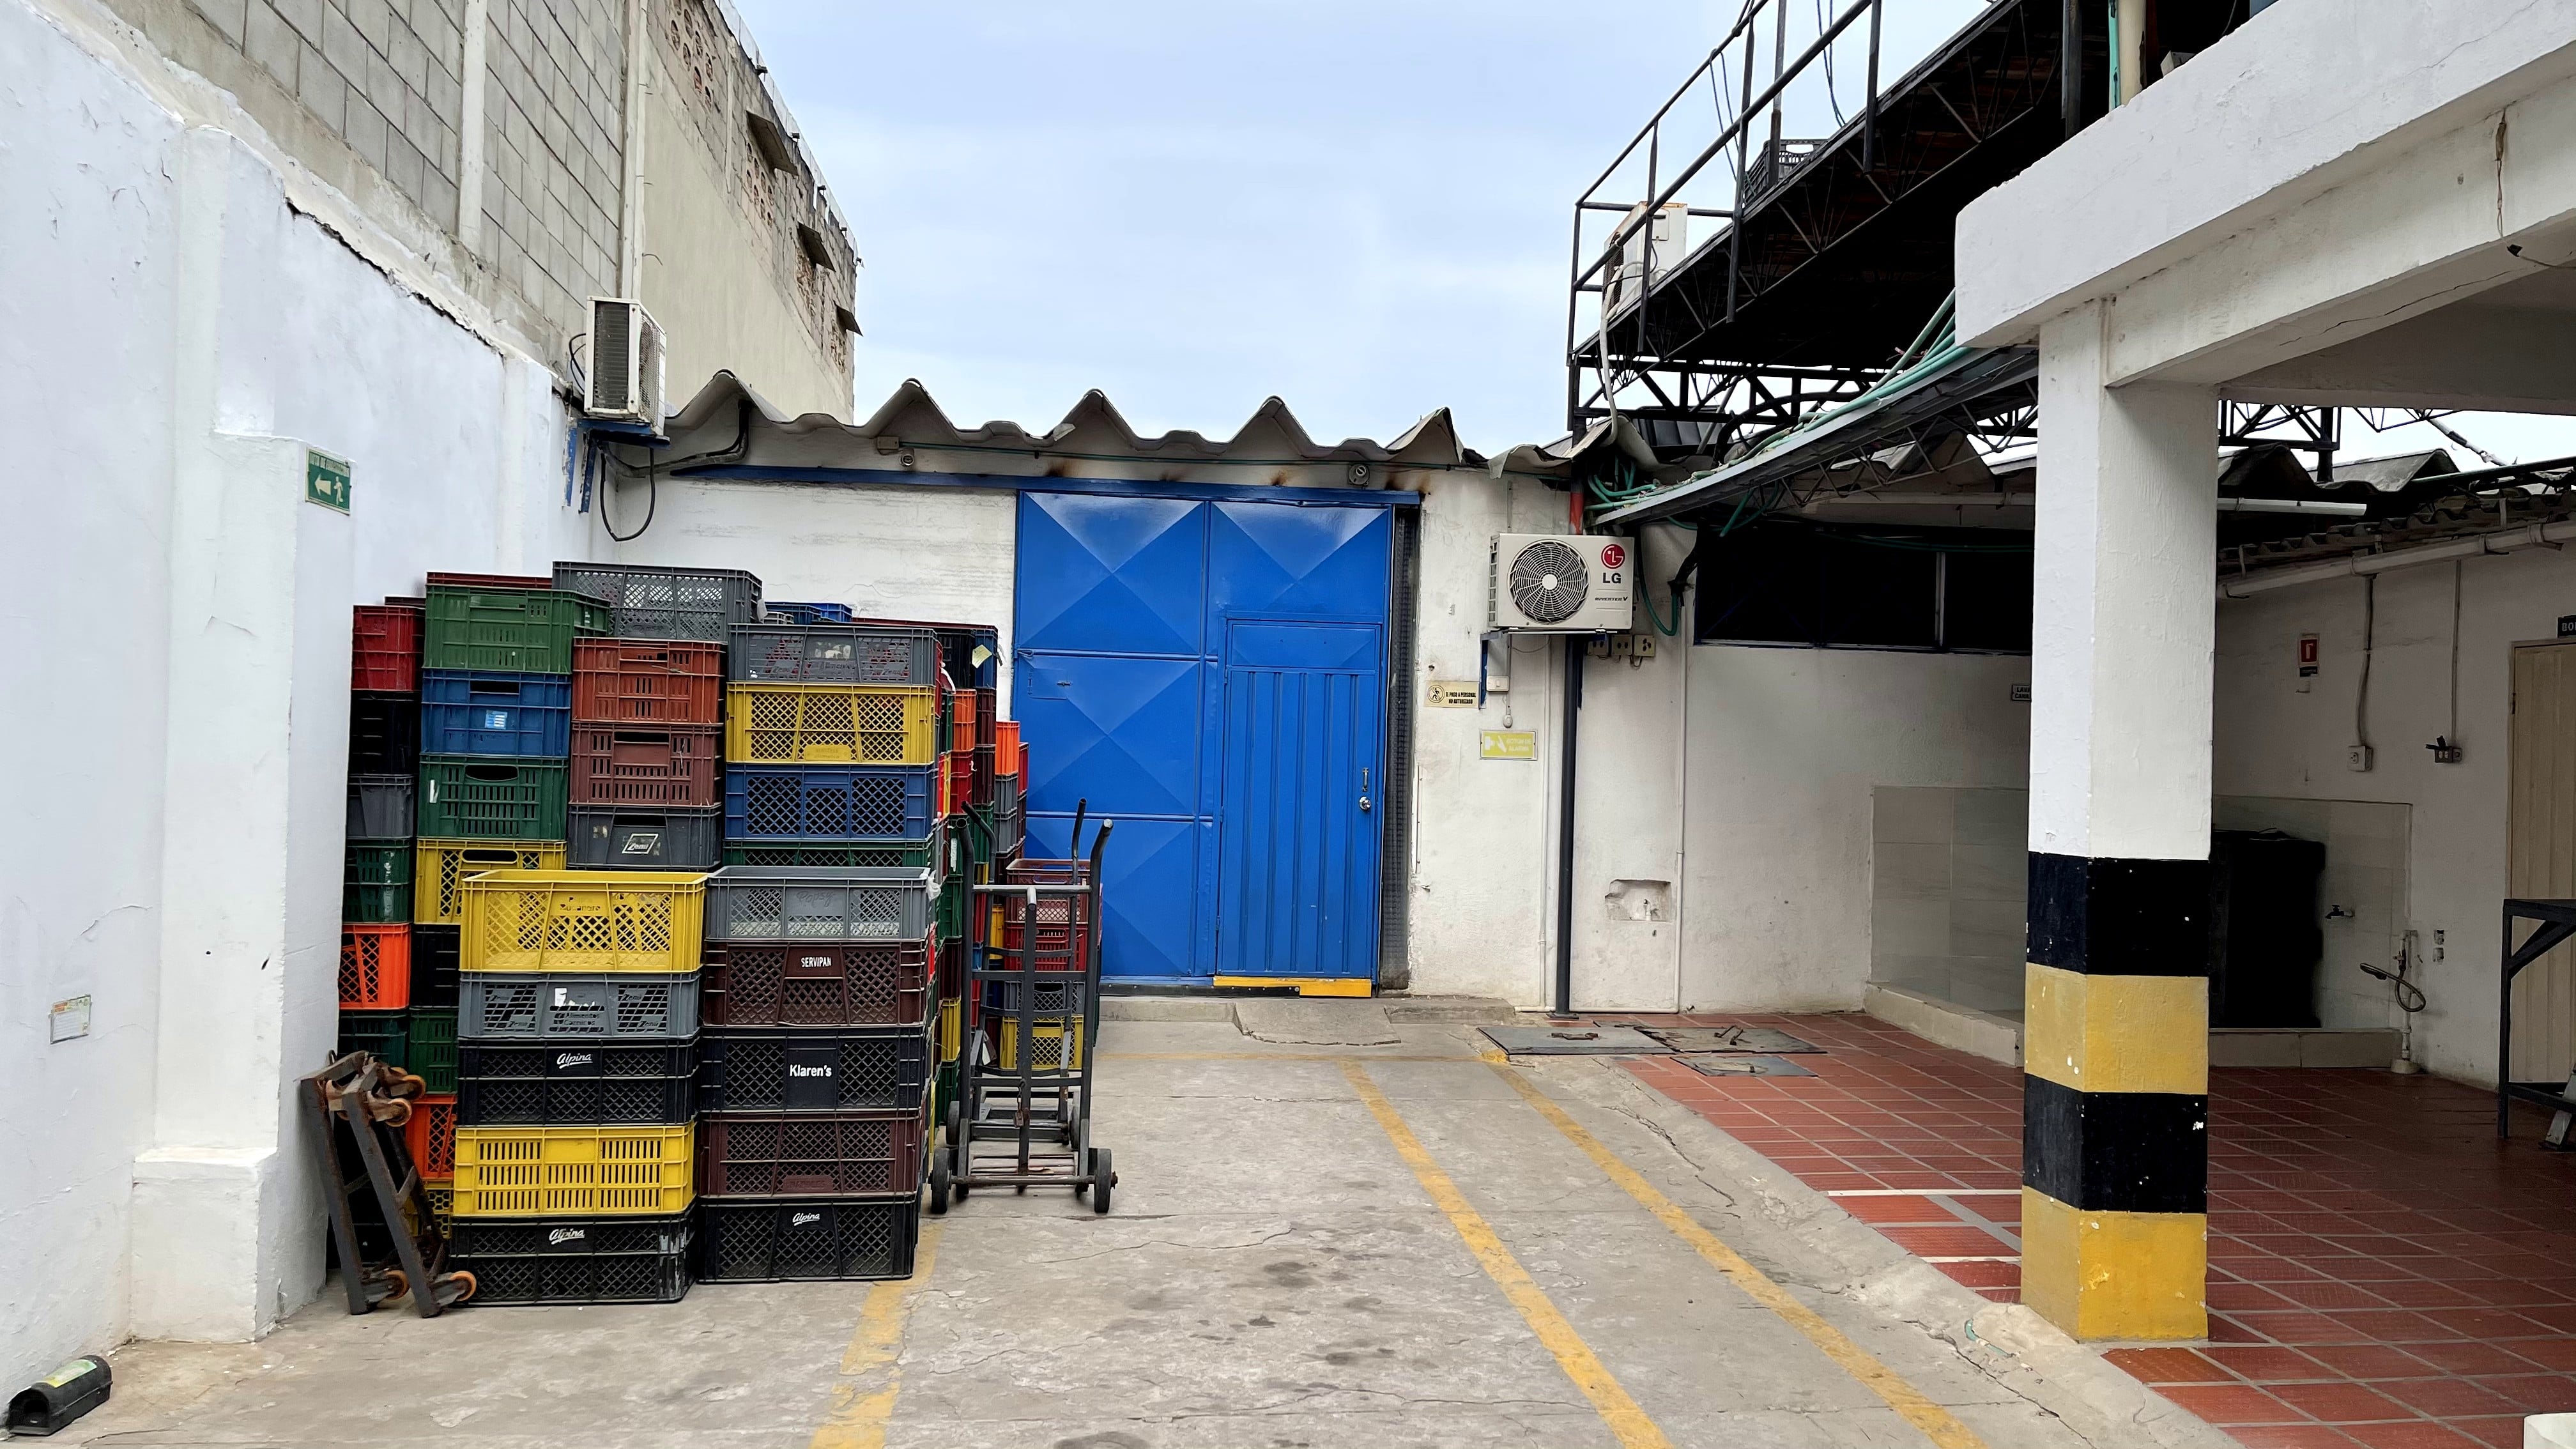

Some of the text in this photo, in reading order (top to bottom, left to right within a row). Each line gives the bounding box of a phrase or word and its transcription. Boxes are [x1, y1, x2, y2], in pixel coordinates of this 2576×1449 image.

[1602, 572, 1621, 583] LG
[2562, 622, 2576, 631] BO
[801, 956, 832, 967] SERVIPAN
[557, 1053, 592, 1068] Alpina
[790, 1064, 832, 1077] Klaren's
[793, 1213, 820, 1225] Alpina
[549, 1228, 585, 1243] Alpina
